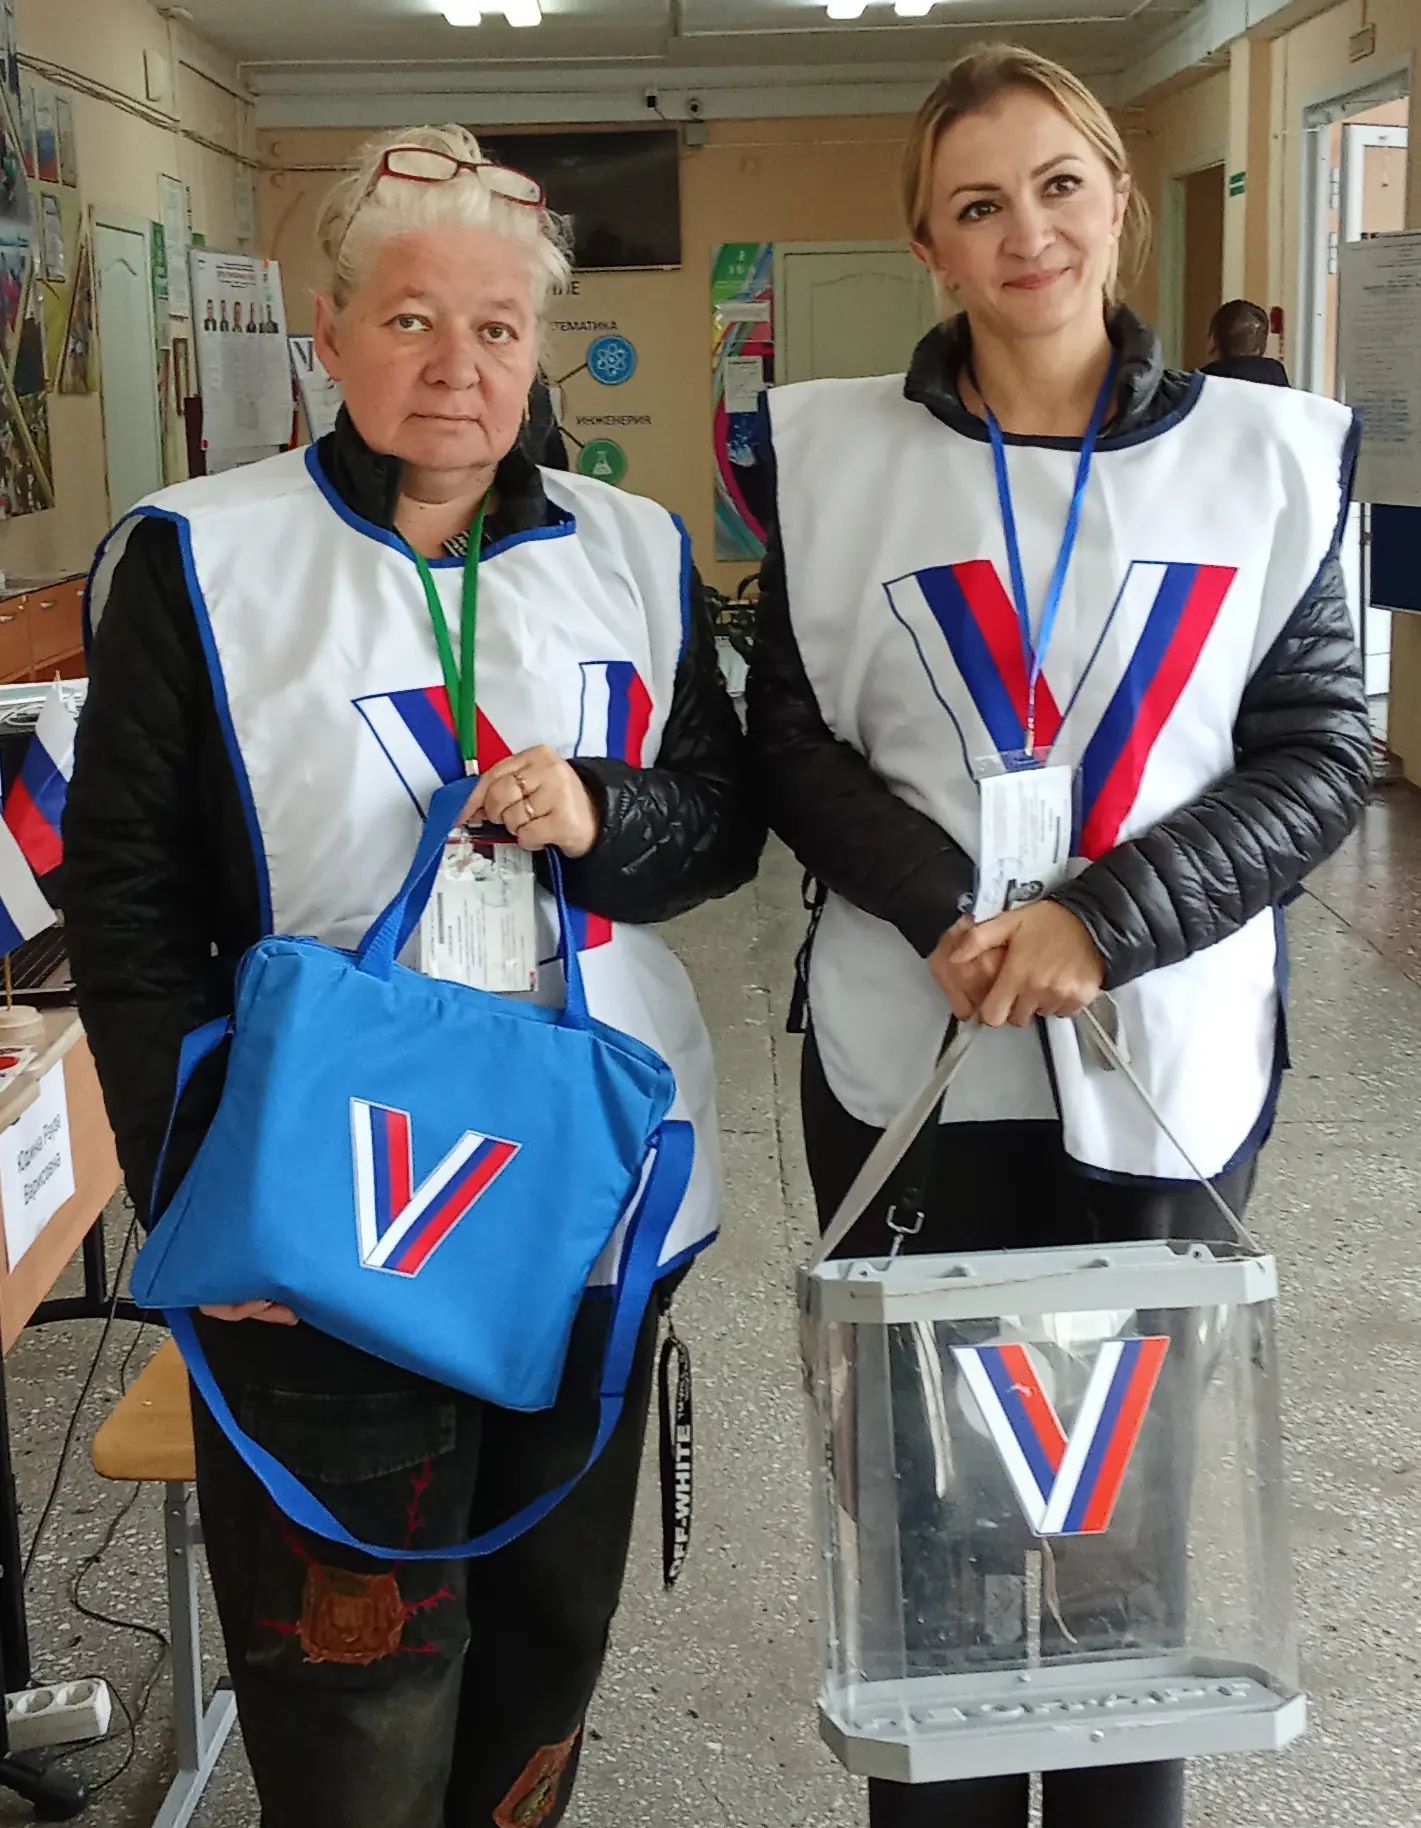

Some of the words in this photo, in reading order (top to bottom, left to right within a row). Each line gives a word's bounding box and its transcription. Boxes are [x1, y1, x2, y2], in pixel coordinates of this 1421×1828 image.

[548, 320, 618, 332] ТЕМАТИКА
[575, 415, 652, 426] ИНЖЕНЕРИЯ
[350, 1096, 524, 1279] V
[668, 1423, 692, 1579] OFF-WHITE
[948, 1335, 1171, 1538] V
